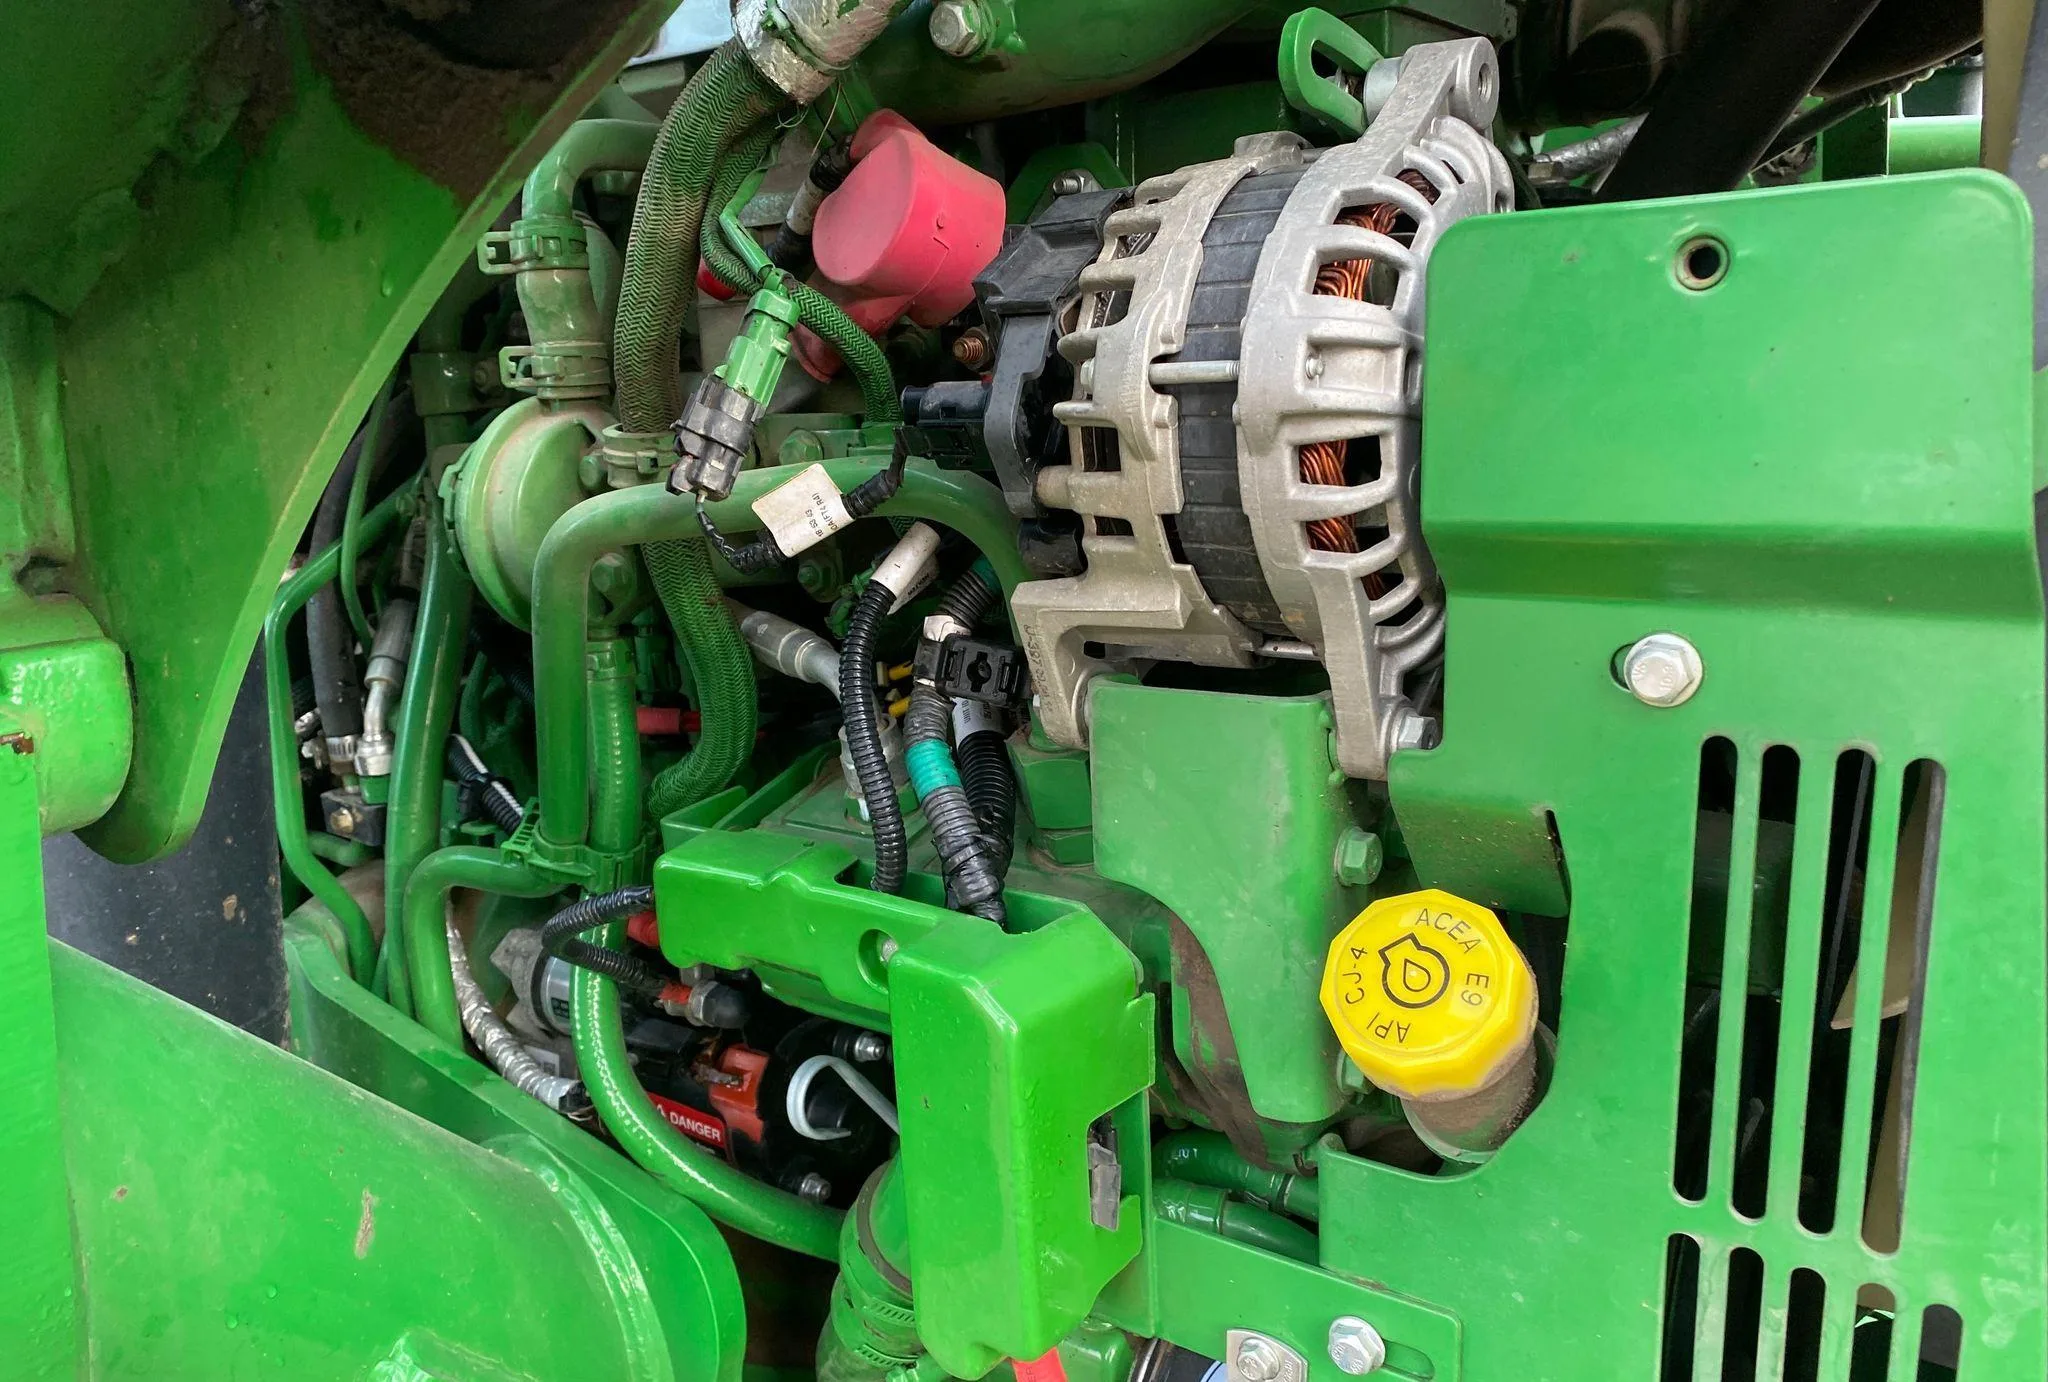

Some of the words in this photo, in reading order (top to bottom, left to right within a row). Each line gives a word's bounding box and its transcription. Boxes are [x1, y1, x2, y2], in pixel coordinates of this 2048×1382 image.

[1342, 946, 1368, 1005] CJ-4
[1415, 908, 1482, 954] ACEA
[1461, 972, 1490, 1007] E9
[1366, 1012, 1412, 1044] API
[669, 1111, 721, 1142] DANGER
